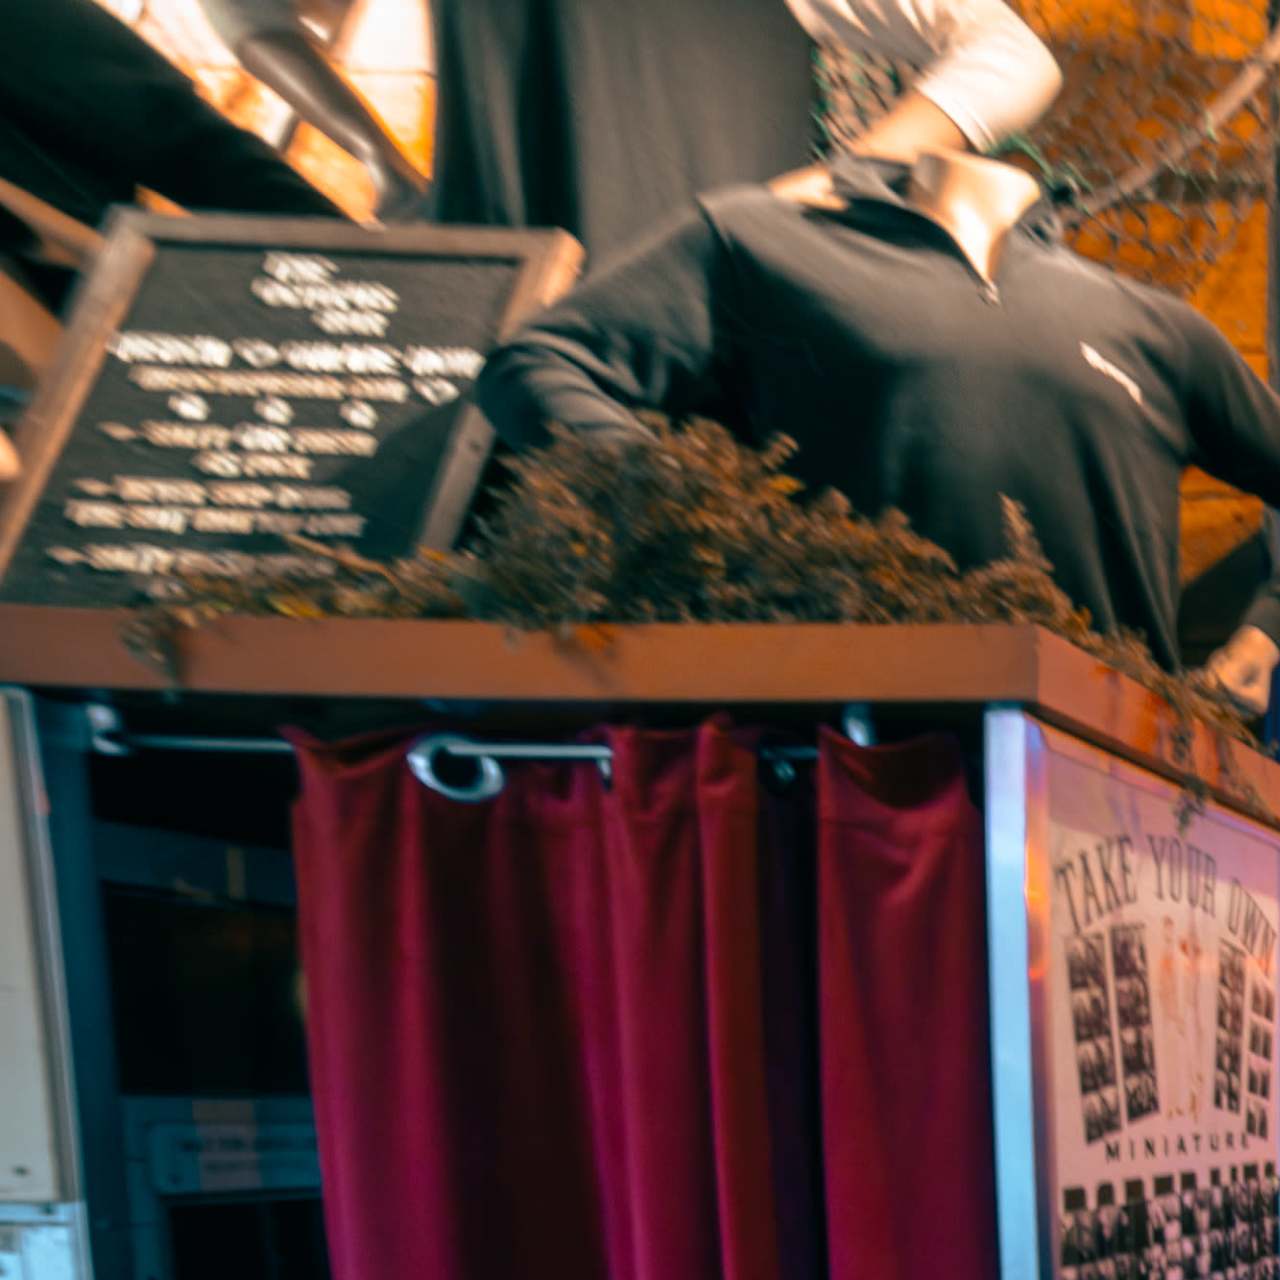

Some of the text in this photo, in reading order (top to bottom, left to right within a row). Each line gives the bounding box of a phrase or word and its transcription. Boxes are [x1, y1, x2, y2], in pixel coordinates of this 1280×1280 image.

[1054, 834, 1278, 978] TAKE YOUR OWN
[1105, 1133, 1248, 1163] MINIATURE
